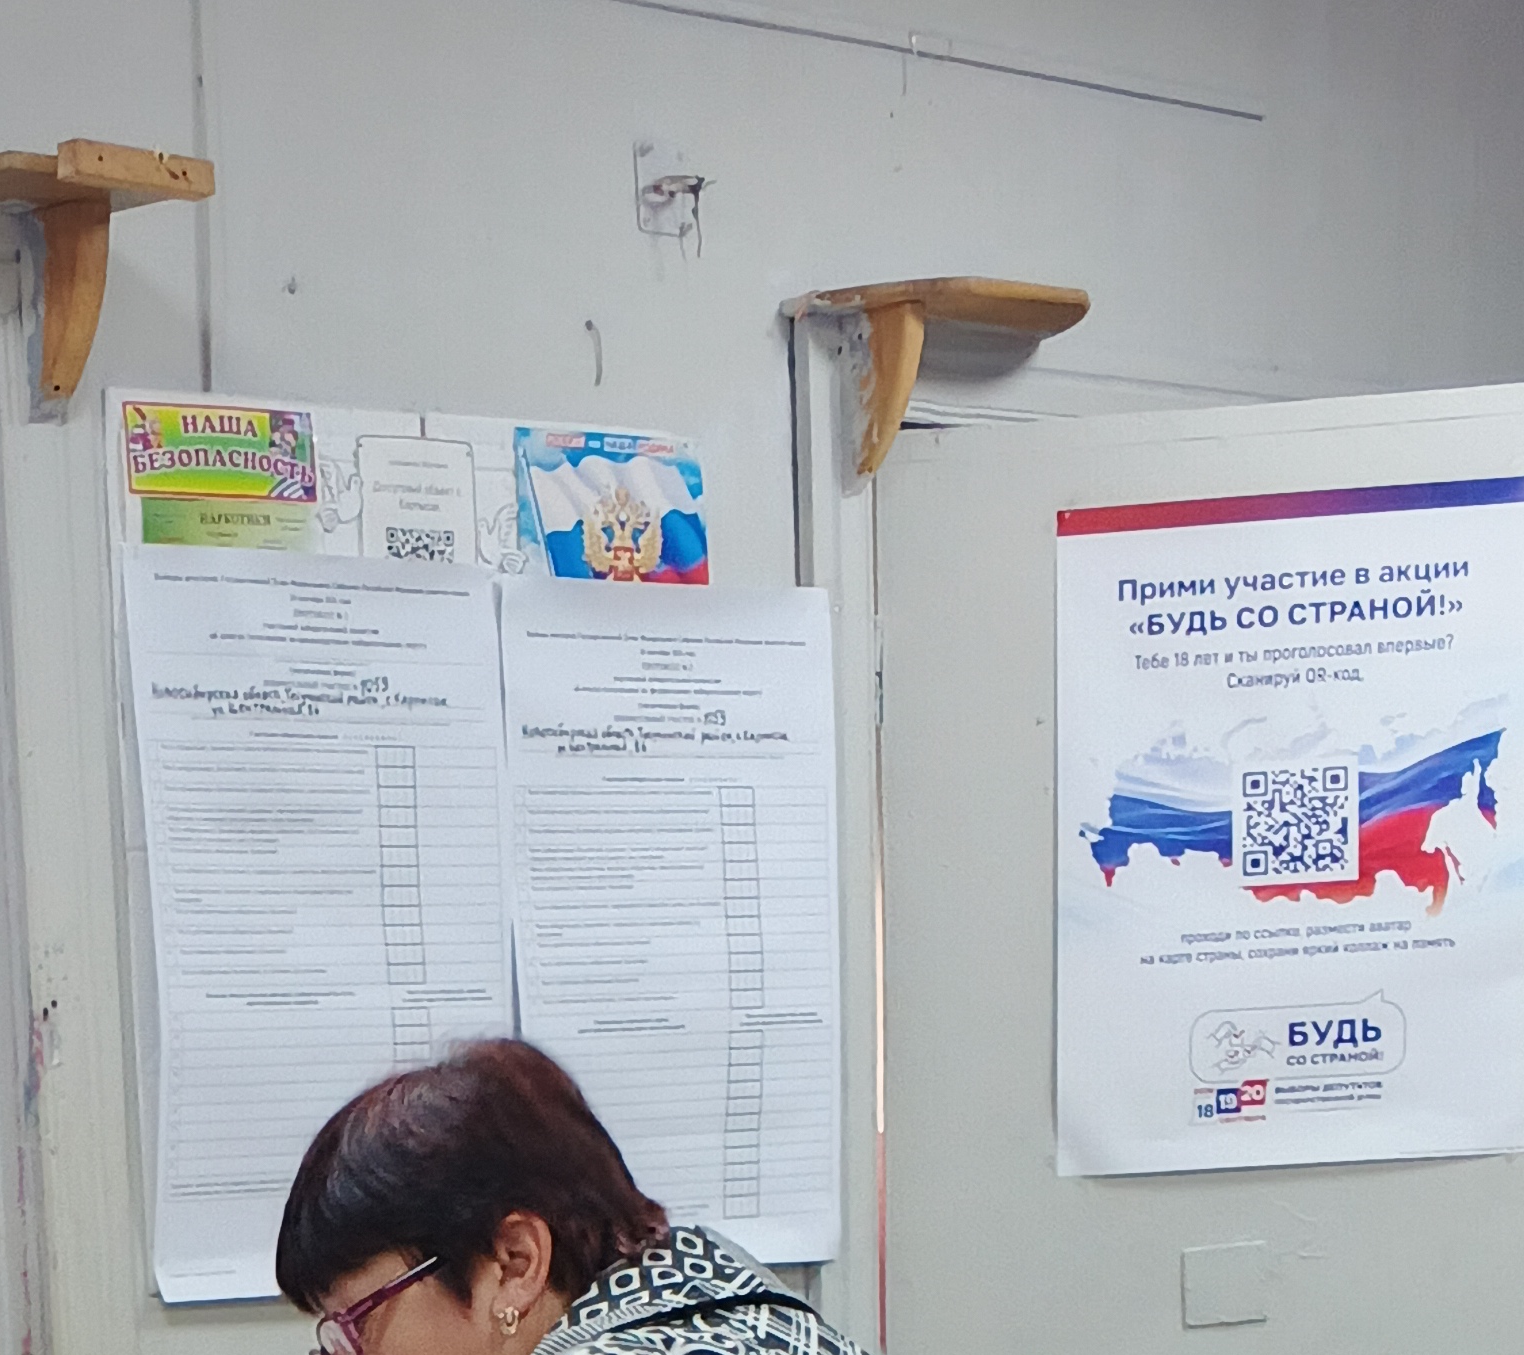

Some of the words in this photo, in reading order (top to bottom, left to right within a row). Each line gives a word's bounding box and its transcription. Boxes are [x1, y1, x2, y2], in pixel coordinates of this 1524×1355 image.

[181, 414, 258, 438] НАША
[132, 447, 315, 486] БЕЗОПАСНОСТЬ
[1117, 578, 1216, 606] Прими
[1223, 567, 1347, 600] участие
[1354, 566, 1372, 586] в
[1378, 560, 1470, 584] акции
[1128, 609, 1228, 637] «БУДЬ
[1236, 605, 1279, 630] СО
[1287, 588, 1464, 627] СТРАНОЙ!»
[1135, 653, 1170, 671] Тебе
[1175, 651, 1190, 668] 18
[1193, 652, 1220, 668] лет
[1238, 649, 1259, 665] ты
[1263, 642, 1372, 667] проголосовал
[1377, 633, 1455, 657] впервые?
[1226, 668, 1301, 690] Сканируй
[1287, 1017, 1383, 1050] БУДЬ
[1286, 1054, 1307, 1066] СО
[1196, 1104, 1215, 1119] 18
[1239, 1084, 1265, 1102] 20
